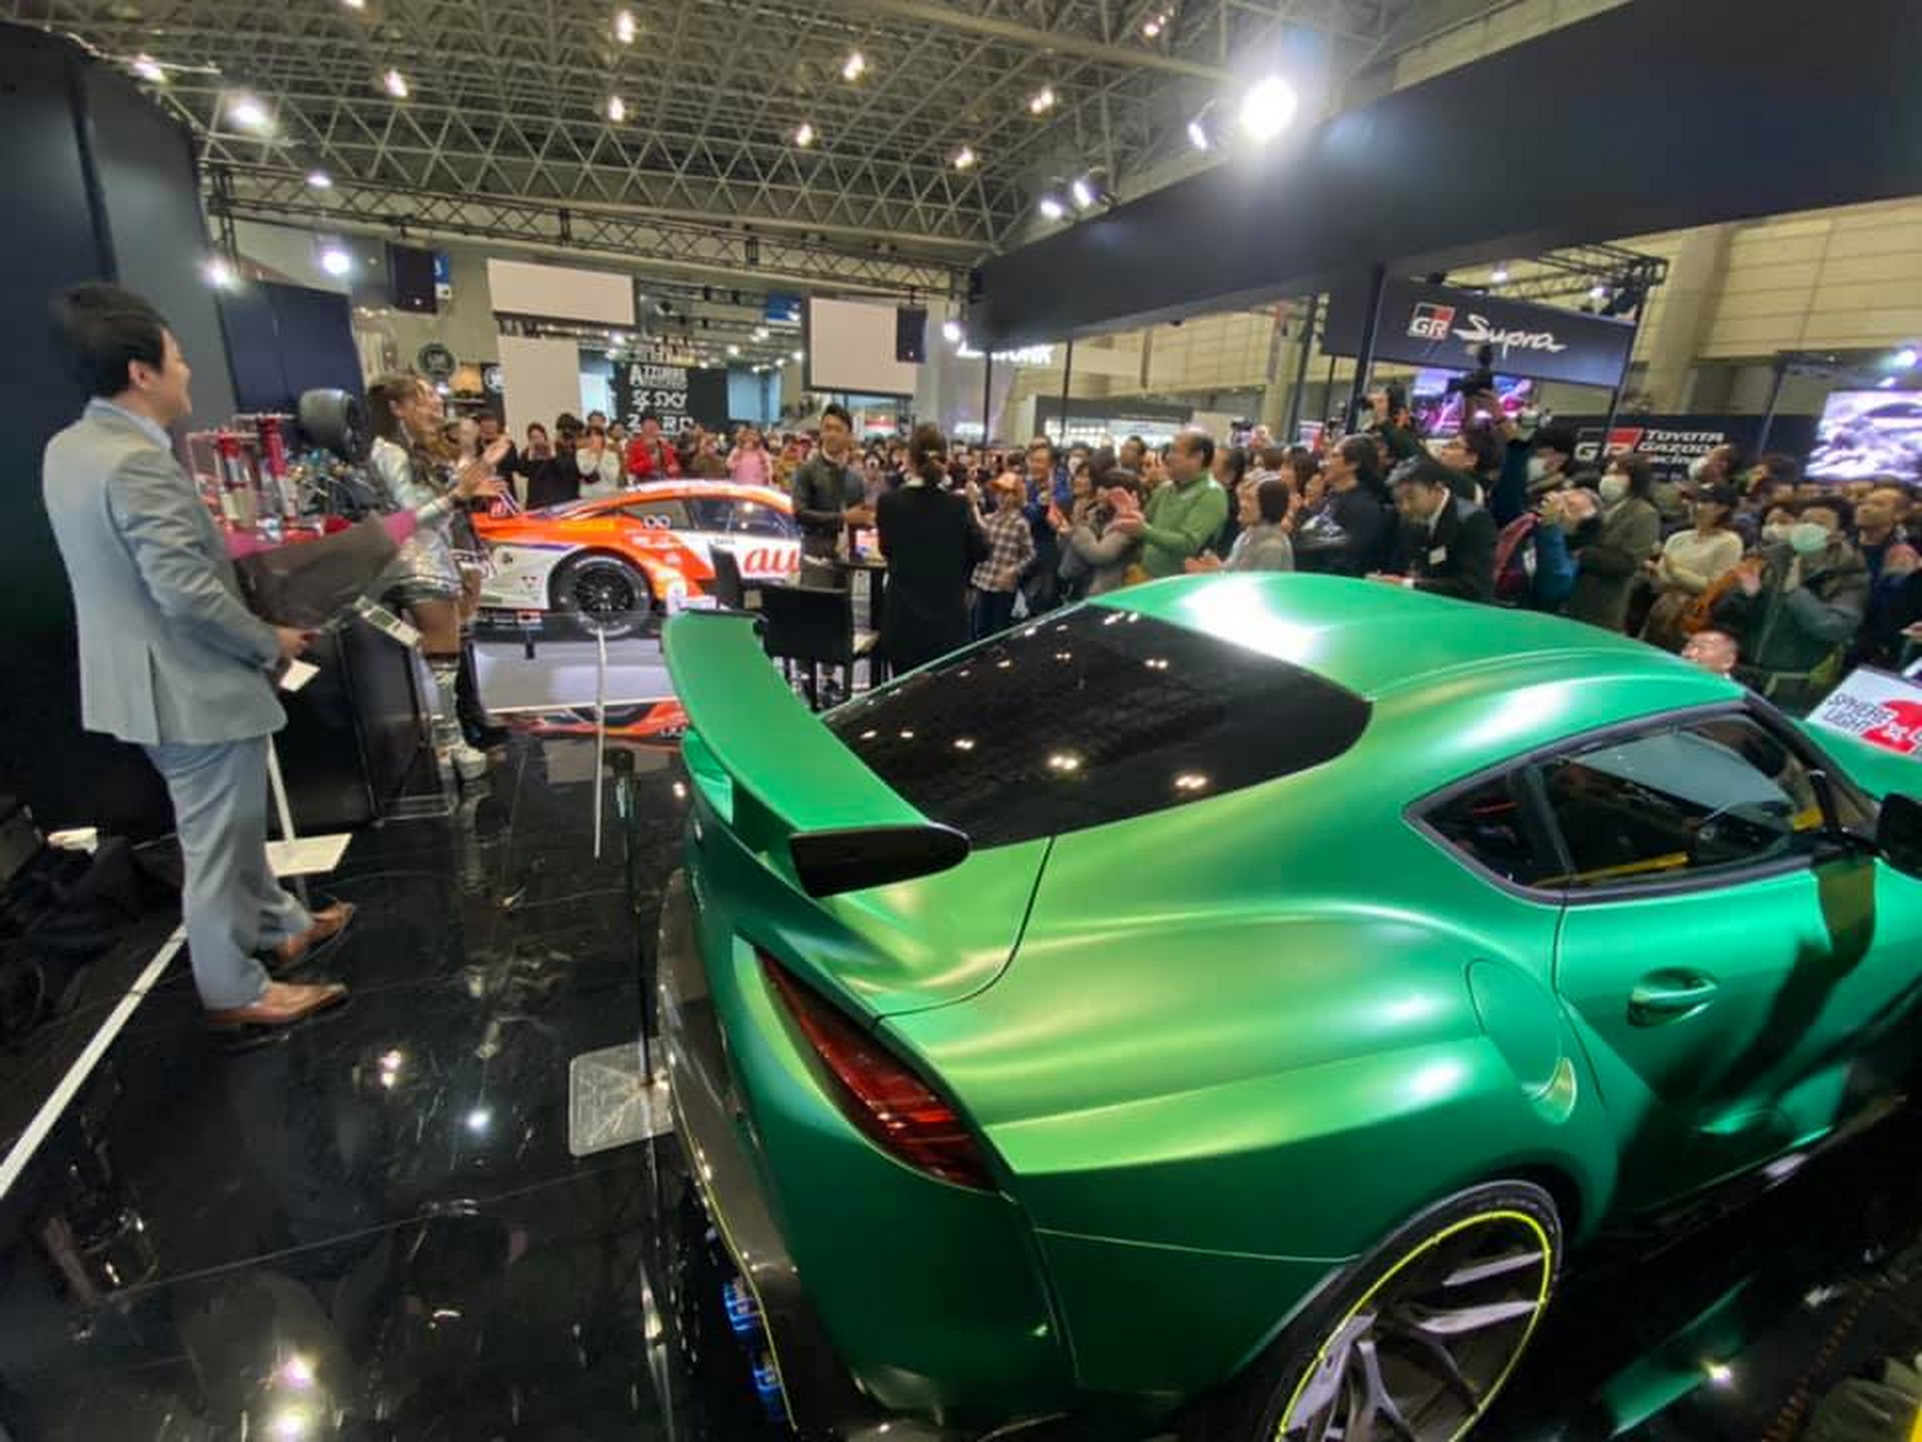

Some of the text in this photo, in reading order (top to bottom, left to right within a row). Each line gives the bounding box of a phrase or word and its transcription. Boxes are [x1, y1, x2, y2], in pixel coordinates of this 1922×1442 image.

[1410, 314, 1567, 359] GR Supra
[1645, 430, 1725, 442] TOYOTA
[743, 547, 800, 573] au
